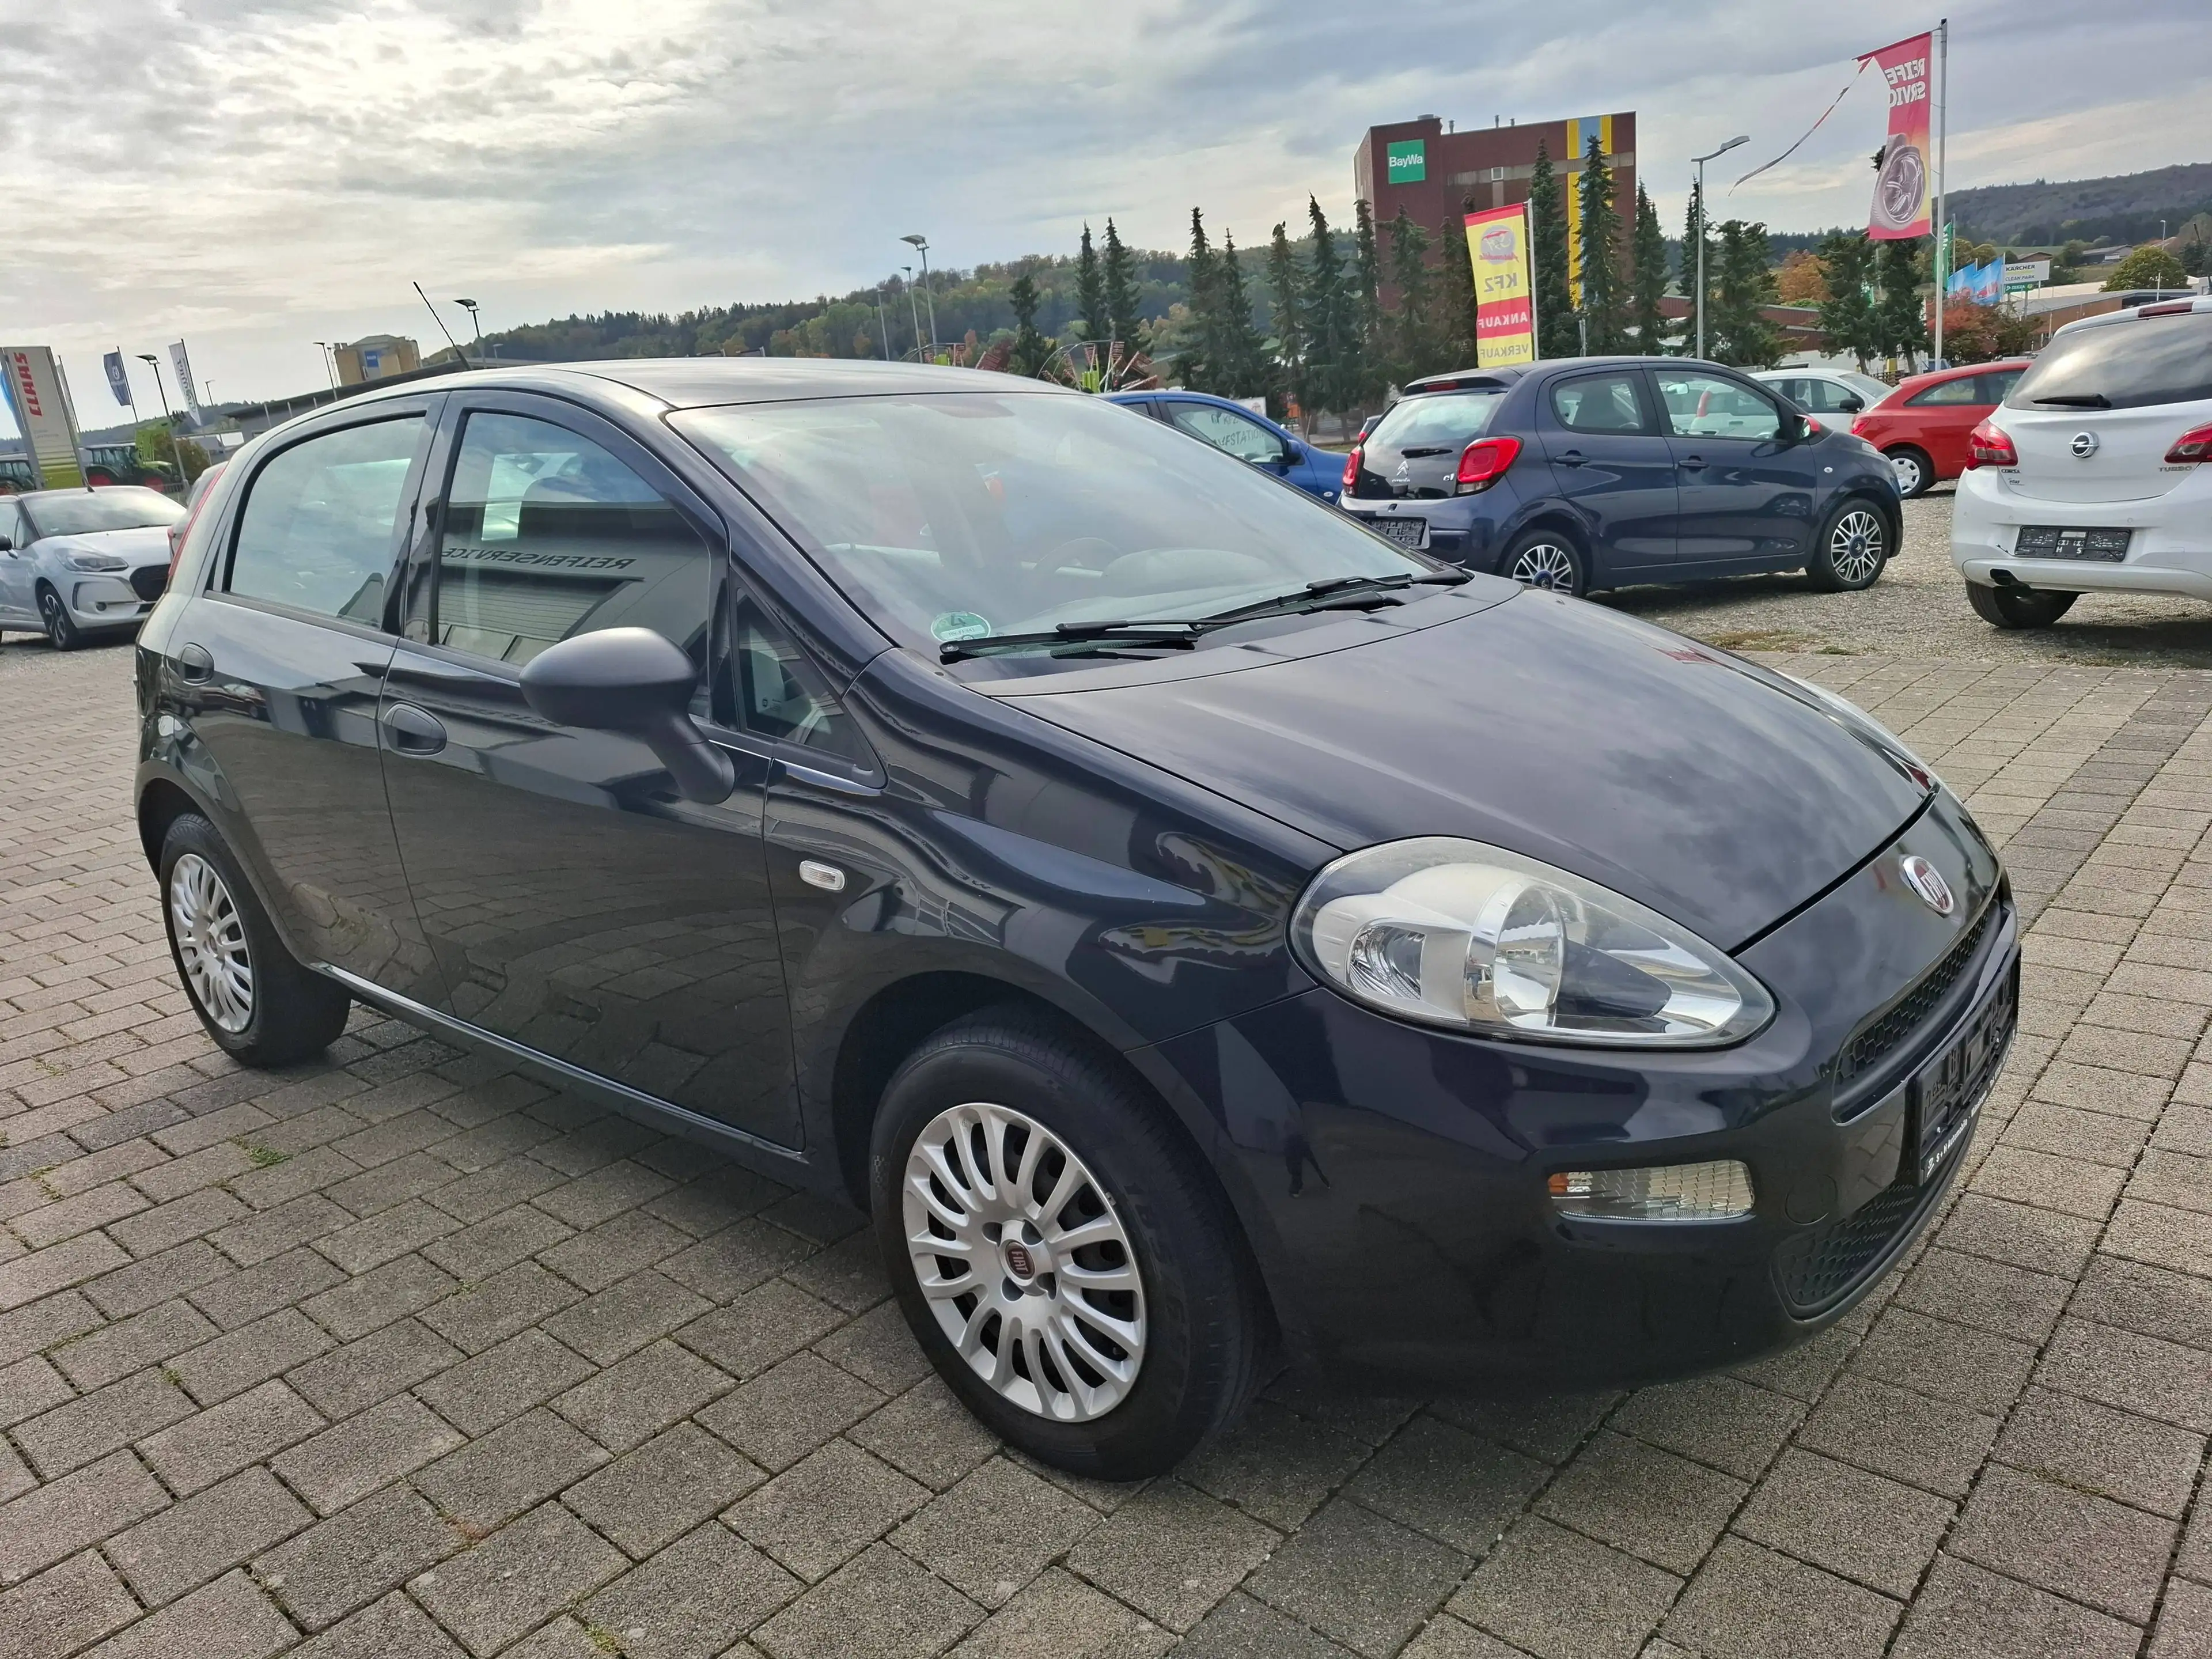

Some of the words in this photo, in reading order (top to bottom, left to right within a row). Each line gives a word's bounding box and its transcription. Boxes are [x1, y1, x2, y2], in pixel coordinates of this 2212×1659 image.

[1389, 154, 1423, 168] BayWa
[13, 352, 43, 417] CLAAS
[951, 615, 967, 627] 4
[1012, 1251, 1028, 1272] FIAT
